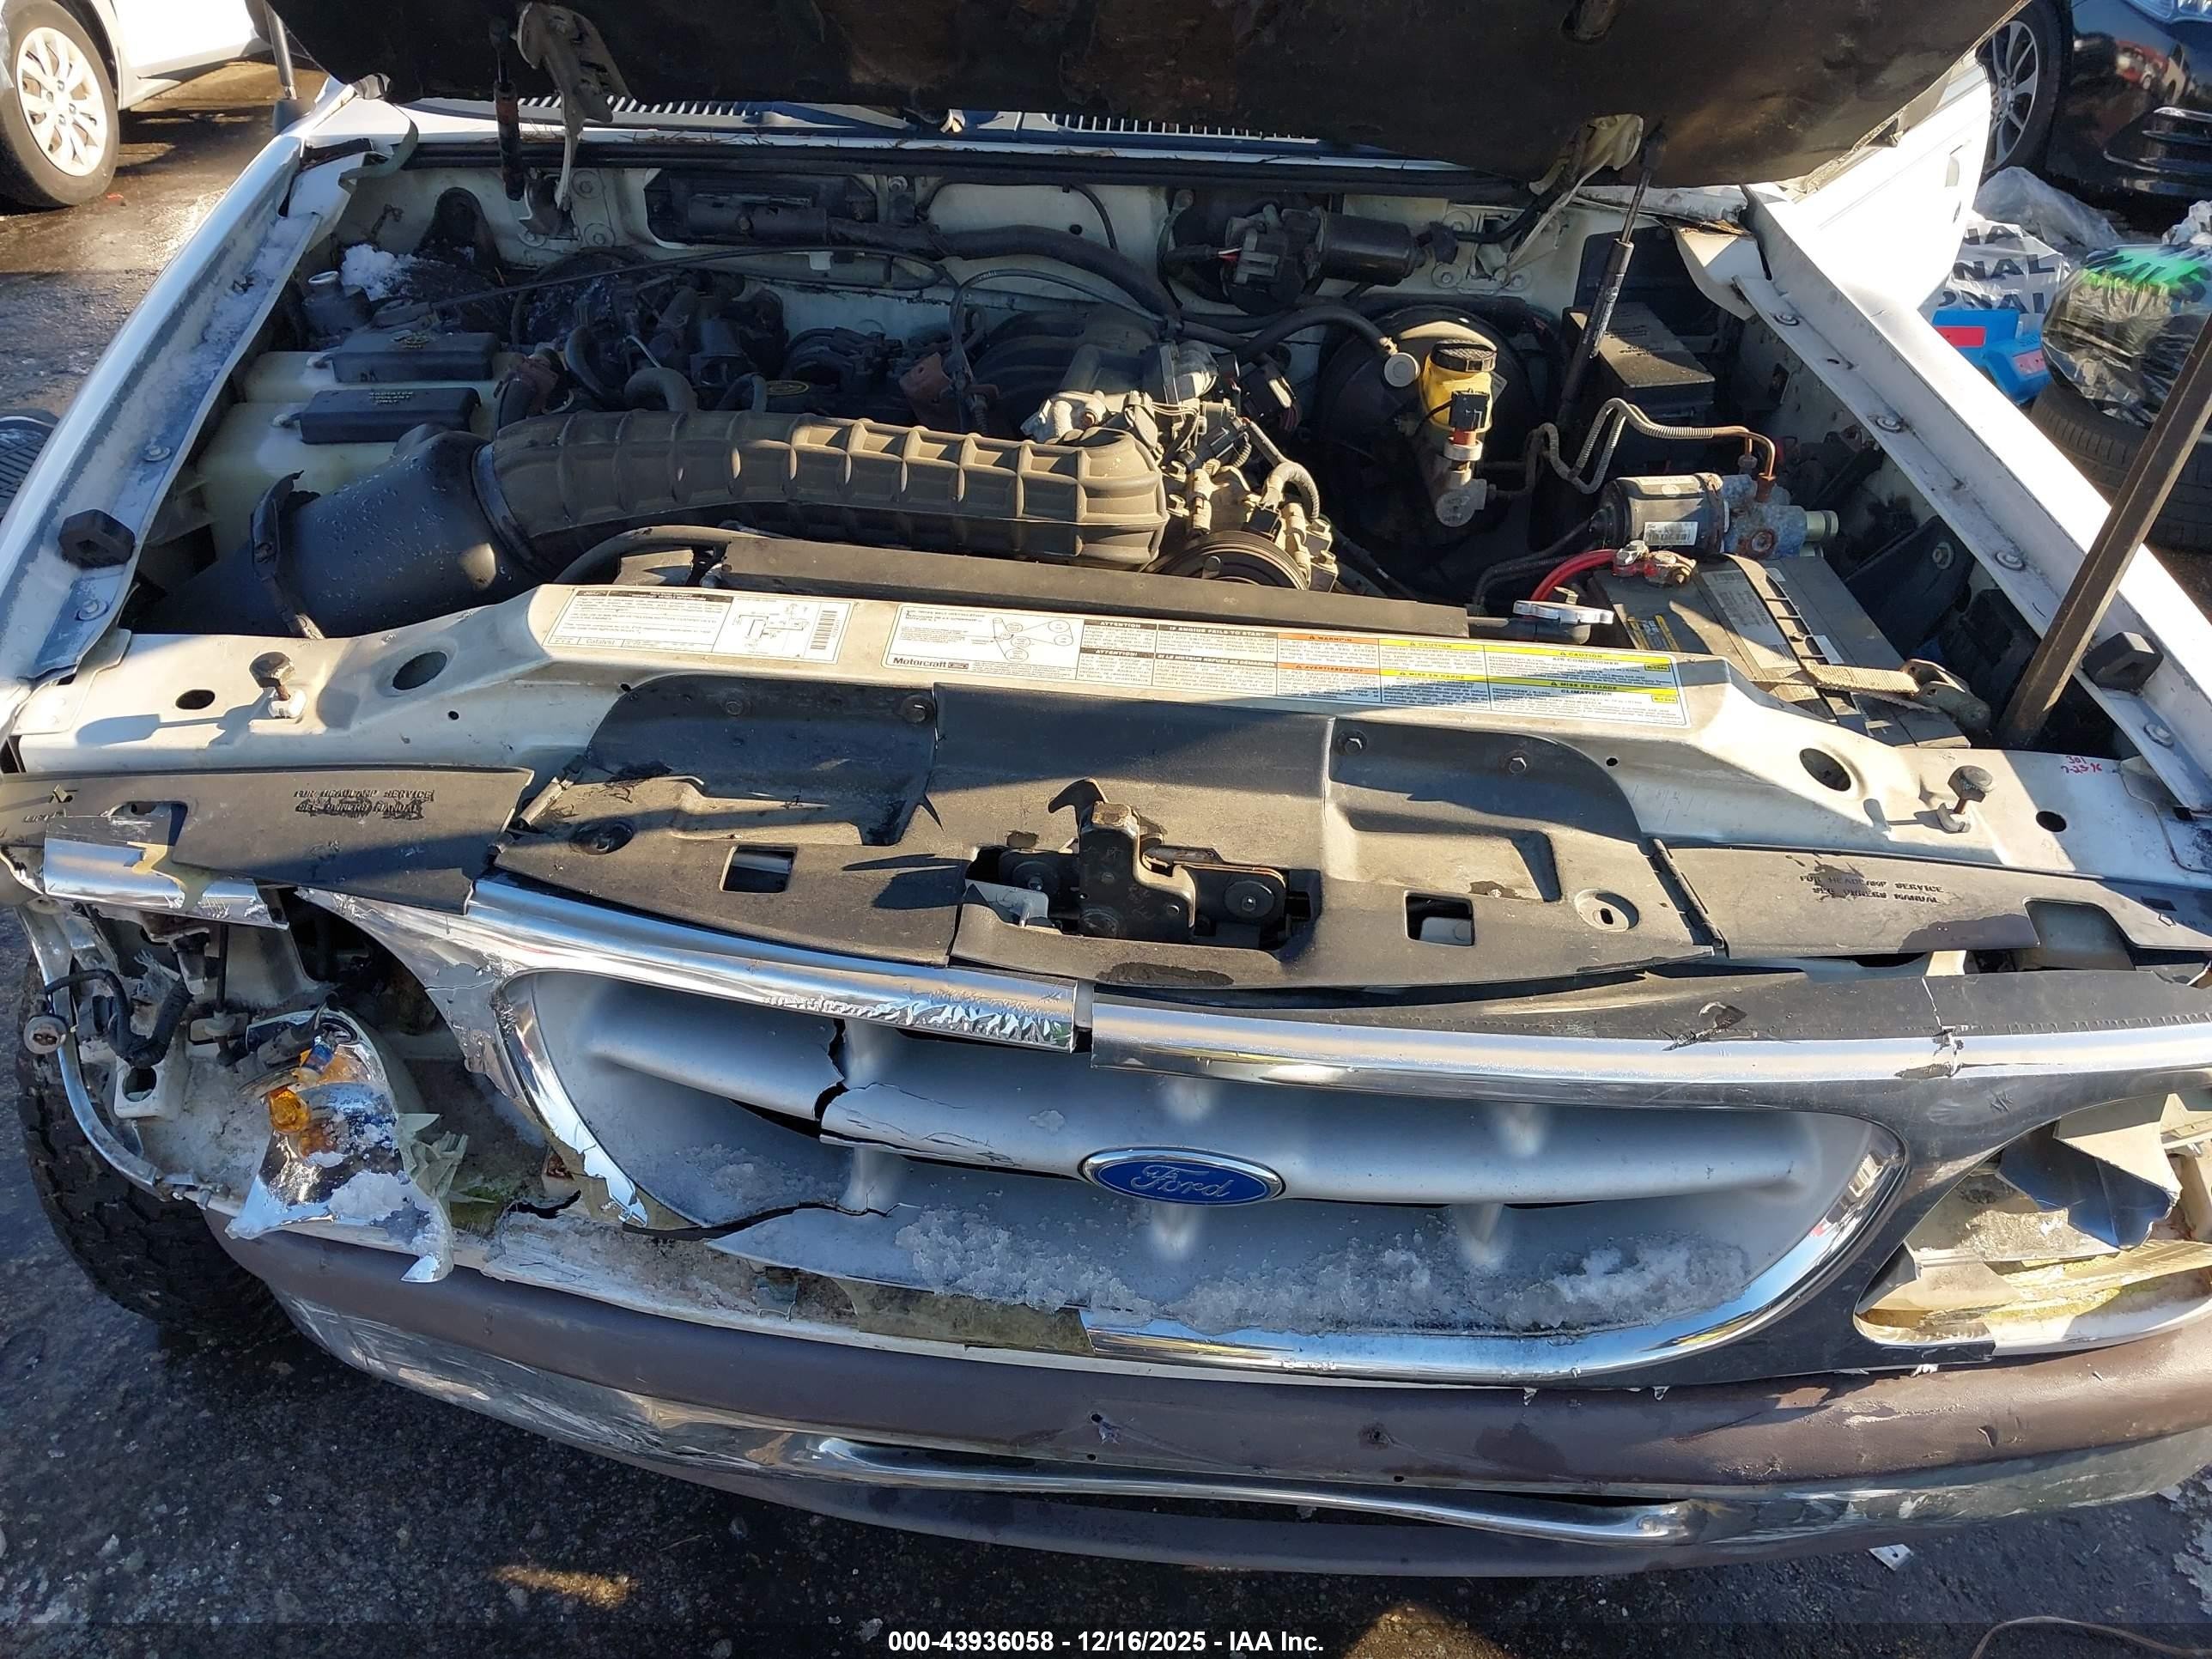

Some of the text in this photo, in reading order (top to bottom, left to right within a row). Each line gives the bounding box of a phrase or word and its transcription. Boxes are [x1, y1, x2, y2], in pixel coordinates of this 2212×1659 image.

[893, 656, 946, 668] Motorcraft
[383, 789, 434, 799] SERVICE
[374, 802, 422, 812] MANUAL
[1800, 875, 1821, 884] FOR
[1894, 882, 1945, 893] SERVICE
[1893, 893, 1939, 903] MANUAL
[1130, 1164, 1234, 1198] Ford
